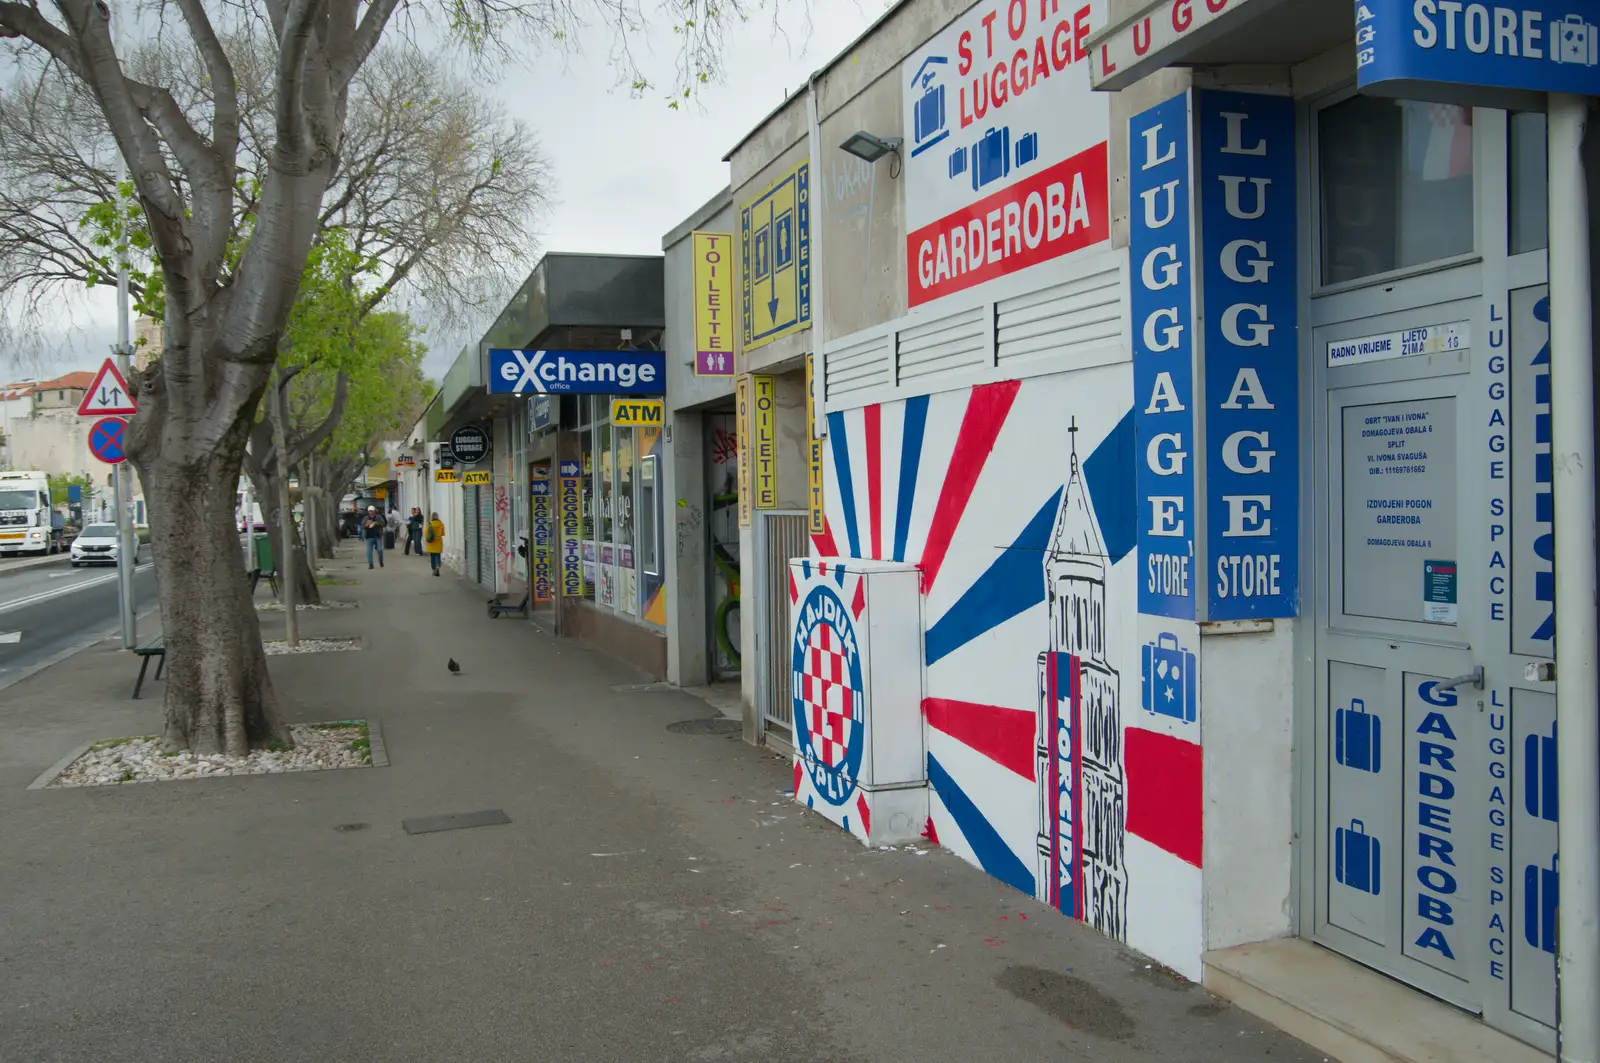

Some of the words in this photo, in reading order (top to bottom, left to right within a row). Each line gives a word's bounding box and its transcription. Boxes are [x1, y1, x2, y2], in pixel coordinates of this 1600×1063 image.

[1413, 0, 1542, 59] STORE
[960, 3, 1091, 129] LUGGAGE
[800, 168, 808, 317] TOILETTE
[918, 172, 1090, 289] GARDEROBA
[705, 236, 722, 349] TOILETTE
[743, 210, 751, 342] TOILETTE
[1140, 123, 1187, 536] LUGGAGE
[1218, 111, 1275, 538] LUGGAGE
[1331, 345, 1356, 359] RADNO
[1358, 340, 1391, 354] VRIJEME
[1402, 329, 1428, 343] LJETO
[1402, 341, 1424, 355] ZIMA
[500, 350, 656, 393] eXchange
[1488, 304, 1505, 479] LUGGAGE
[615, 405, 661, 421] ATM
[1405, 426, 1426, 434] OBALA
[398, 453, 413, 462] dm
[456, 436, 482, 444] LUGGAGE
[456, 444, 483, 452] STORAGE
[757, 382, 772, 503] TOILETTE
[1377, 454, 1395, 462] IVONA
[1388, 440, 1405, 448] SPLIT
[465, 474, 489, 482] ATM
[1367, 500, 1403, 508] IZDVOJENI
[1405, 500, 1432, 508] POGON
[535, 496, 547, 546] BAGGAGE
[564, 480, 579, 536] BAGGAGE
[1377, 515, 1421, 524] GARDEROBA
[564, 539, 579, 594] STORAGE
[1367, 538, 1405, 547] DOMAGOJEVA
[1489, 498, 1505, 620] SPACE
[535, 549, 547, 598] STORAGE
[1148, 553, 1188, 596] STORE
[1217, 553, 1280, 599] STORE
[797, 594, 856, 666] HAJDUK
[805, 743, 852, 800] SPLIT
[1058, 695, 1073, 888] TORCIDA
[1489, 689, 1505, 852] LUGGAGE
[1415, 680, 1458, 961] GARDEROBA
[1489, 866, 1505, 981] SPACE
